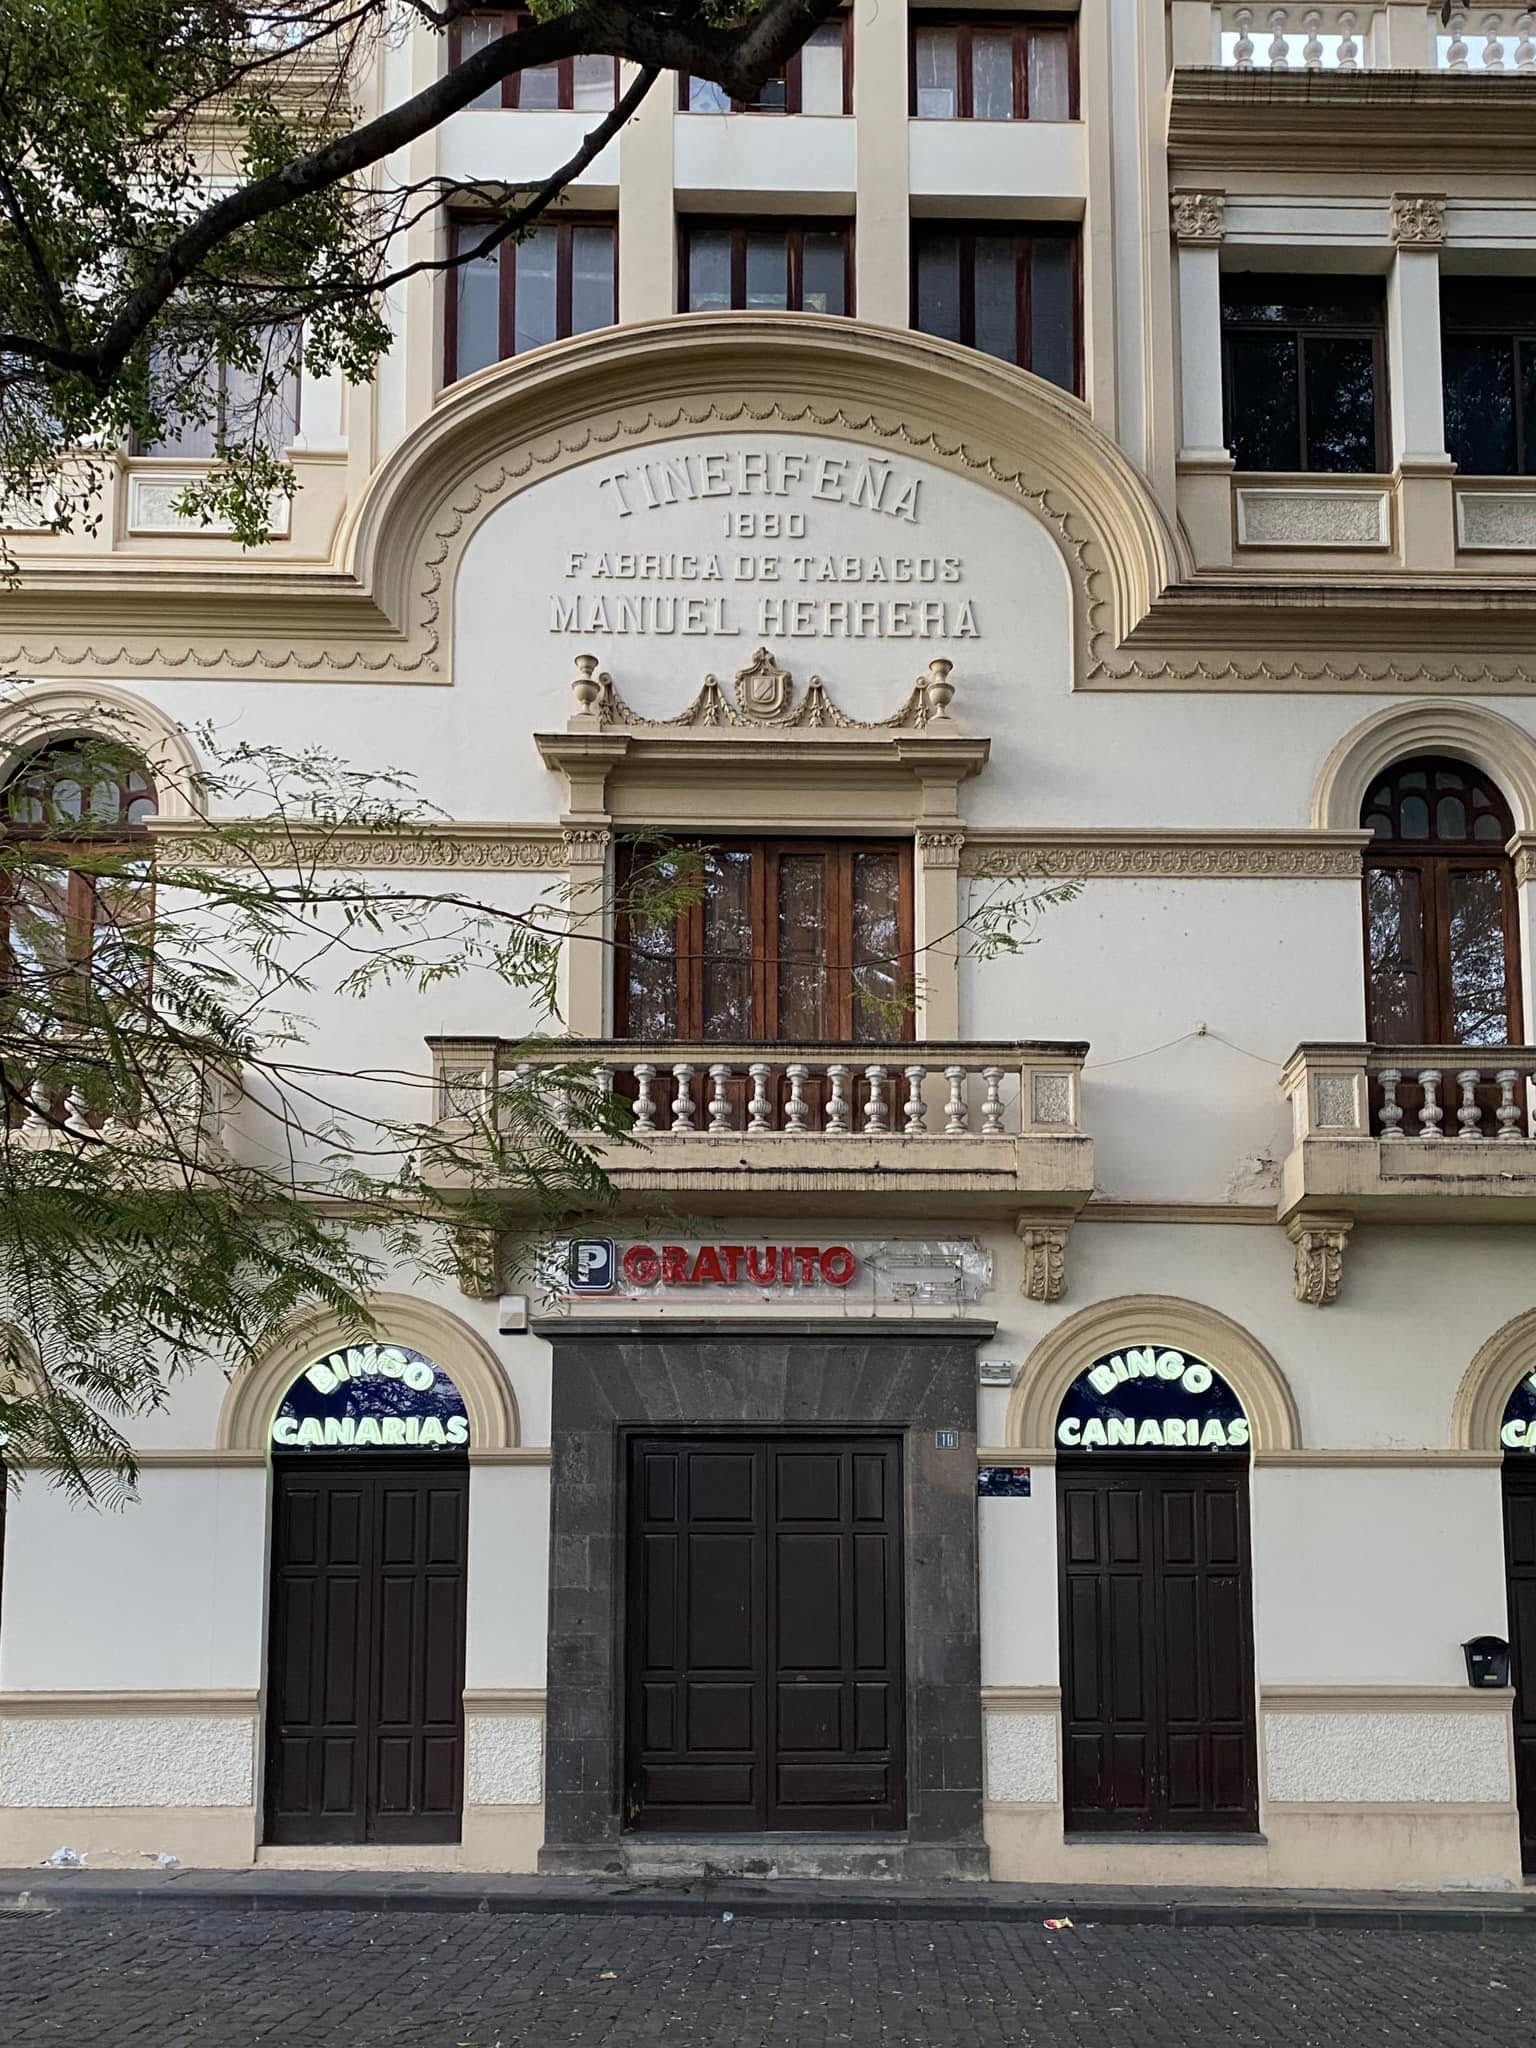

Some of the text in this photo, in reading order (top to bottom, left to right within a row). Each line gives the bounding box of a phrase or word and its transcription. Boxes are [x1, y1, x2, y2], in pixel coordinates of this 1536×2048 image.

[599, 449, 922, 524] TINERFEÑA
[721, 512, 806, 539] 1880
[565, 552, 962, 583] FABRICA DE TABACOS
[550, 595, 981, 639] MANUEL HERRERA
[576, 1245, 857, 1286] P GRATUITO
[305, 1344, 435, 1394] BINGO
[1087, 1347, 1213, 1395] BINGO
[272, 1416, 469, 1445] CANARIAS
[1058, 1417, 1249, 1446] CANARIAS
